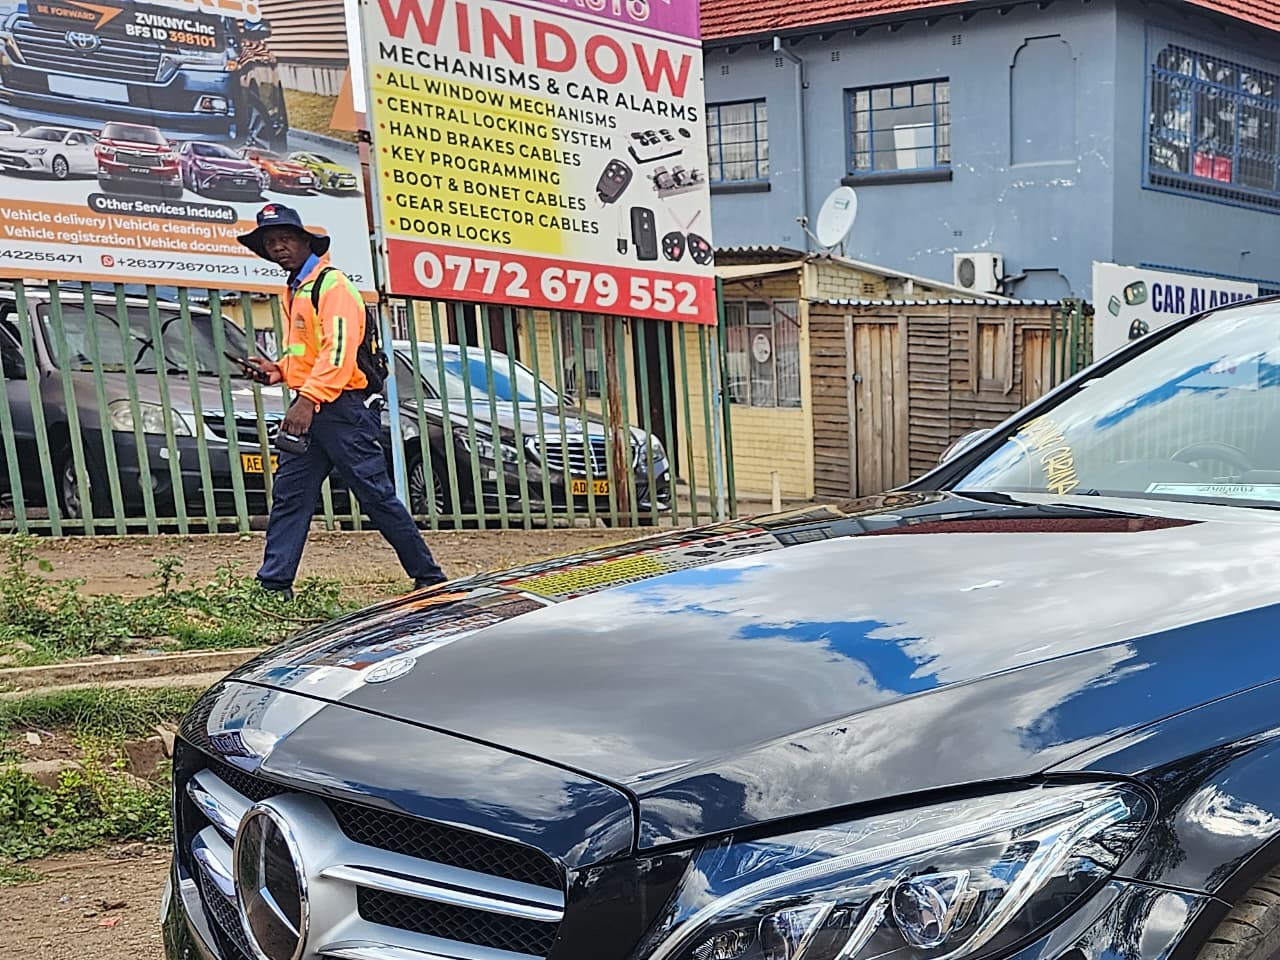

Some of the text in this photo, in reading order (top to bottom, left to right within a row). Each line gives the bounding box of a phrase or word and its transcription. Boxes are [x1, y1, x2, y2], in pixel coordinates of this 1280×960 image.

[50, 7, 96, 20] FORWARD
[134, 12, 215, 35] ZVIKNYC.Inc
[125, 24, 216, 48] BFS ID 398101
[378, 0, 692, 98] WINDOW
[378, 42, 698, 122] MECHANISMS & CAR ALARMS
[386, 72, 618, 129] ALL WINDOW MECHANISMS
[387, 98, 612, 150] CENTRAL LOCKING SYSTEM
[390, 122, 581, 167] HAND BRAKES CABLES
[391, 146, 561, 186] KEY PROGRAMMING
[95, 197, 233, 221] Other Services Include!
[393, 170, 586, 212] BOOT & BONET CABLES
[1, 208, 51, 222] Vehicle
[53, 213, 106, 229] delivery
[114, 218, 160, 232] Vehicle
[162, 222, 211, 238] clearing
[396, 194, 599, 235] GEAR SELECTOR CABLES
[399, 217, 512, 245] DOOR LOCKS
[4, 225, 55, 240] Vehicle
[57, 230, 135, 247] registration
[143, 236, 190, 250] Vehicle
[0, 250, 83, 264] 42255471
[413, 251, 699, 315] 0772 679 552
[1152, 282, 1186, 315] CAR
